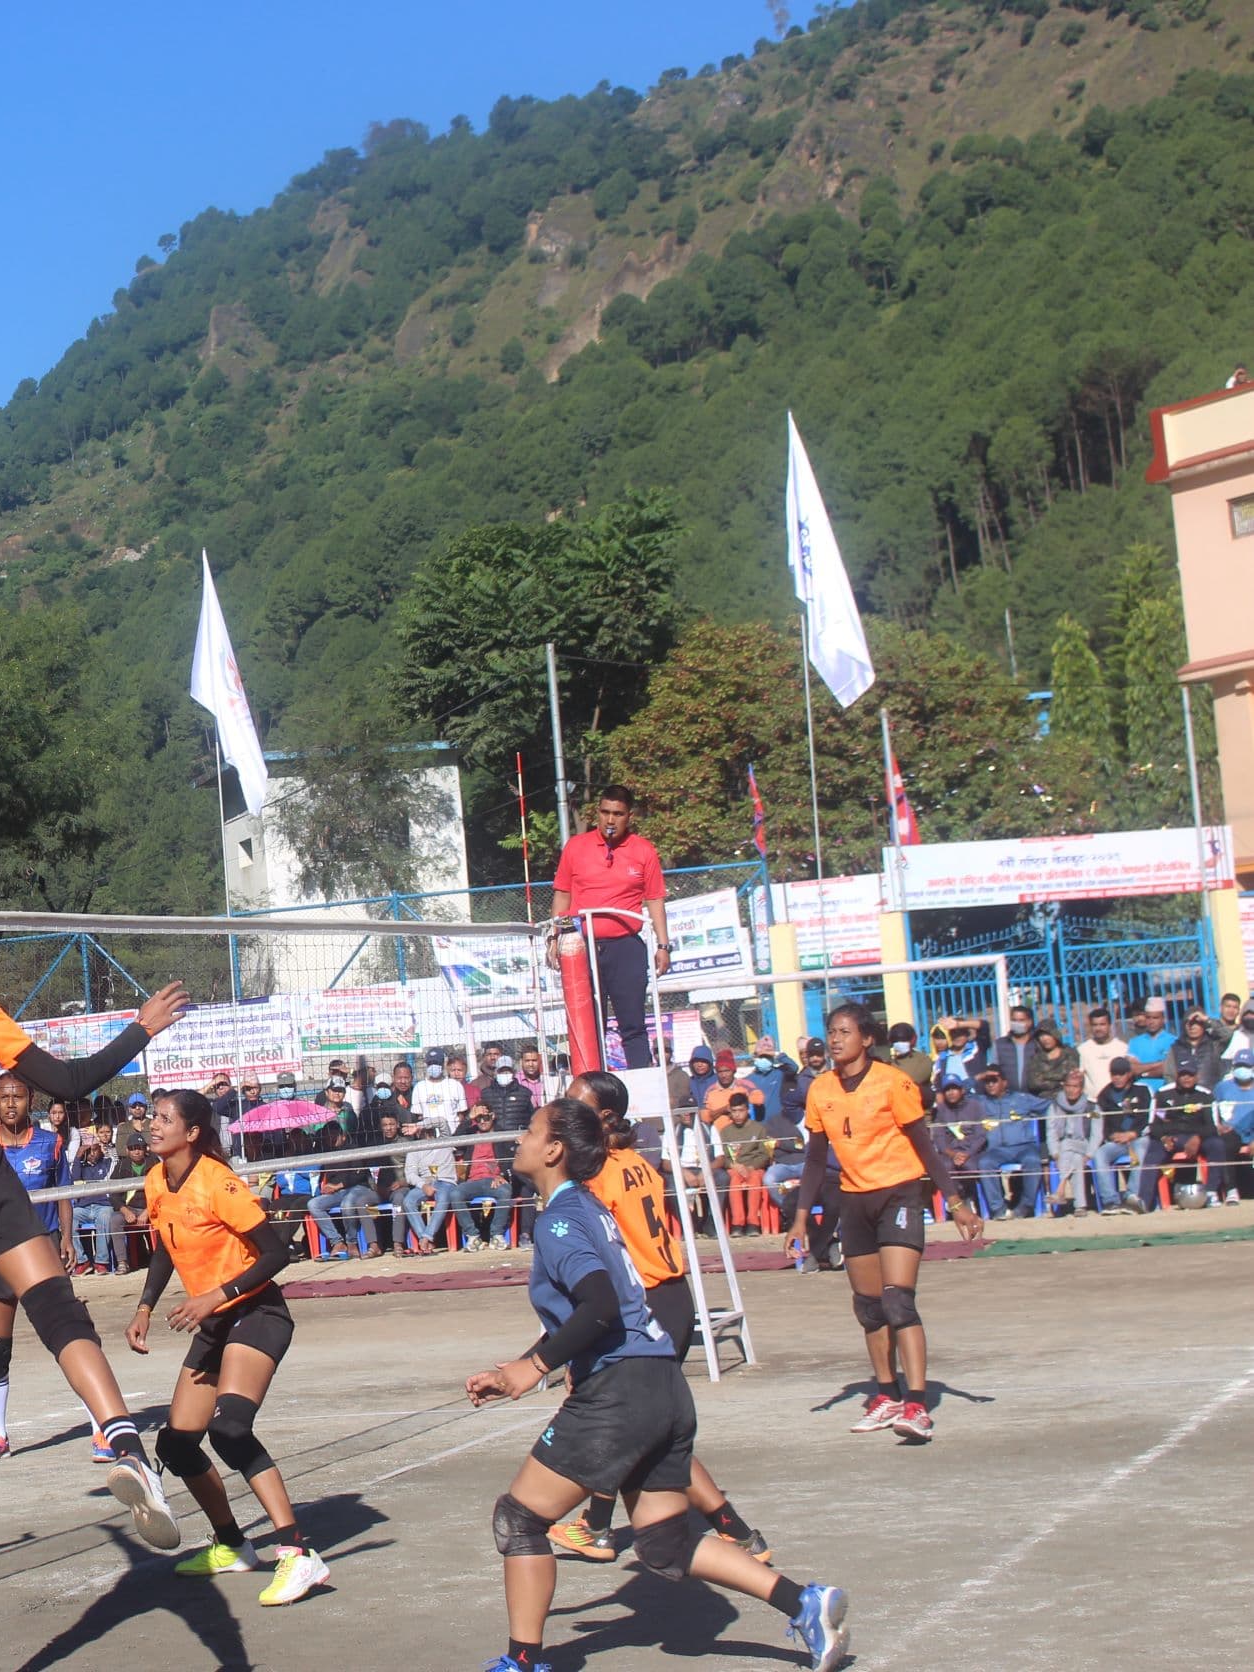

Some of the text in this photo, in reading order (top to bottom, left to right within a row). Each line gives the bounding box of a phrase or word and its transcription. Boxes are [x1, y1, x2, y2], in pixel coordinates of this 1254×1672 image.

[154, 1054, 193, 1073] हार्दिक
[199, 1052, 239, 1068] स्वागत
[843, 1116, 853, 1140] 4
[896, 1206, 909, 1230] 4
[168, 1222, 177, 1250] 1
[642, 1194, 679, 1273] 5
